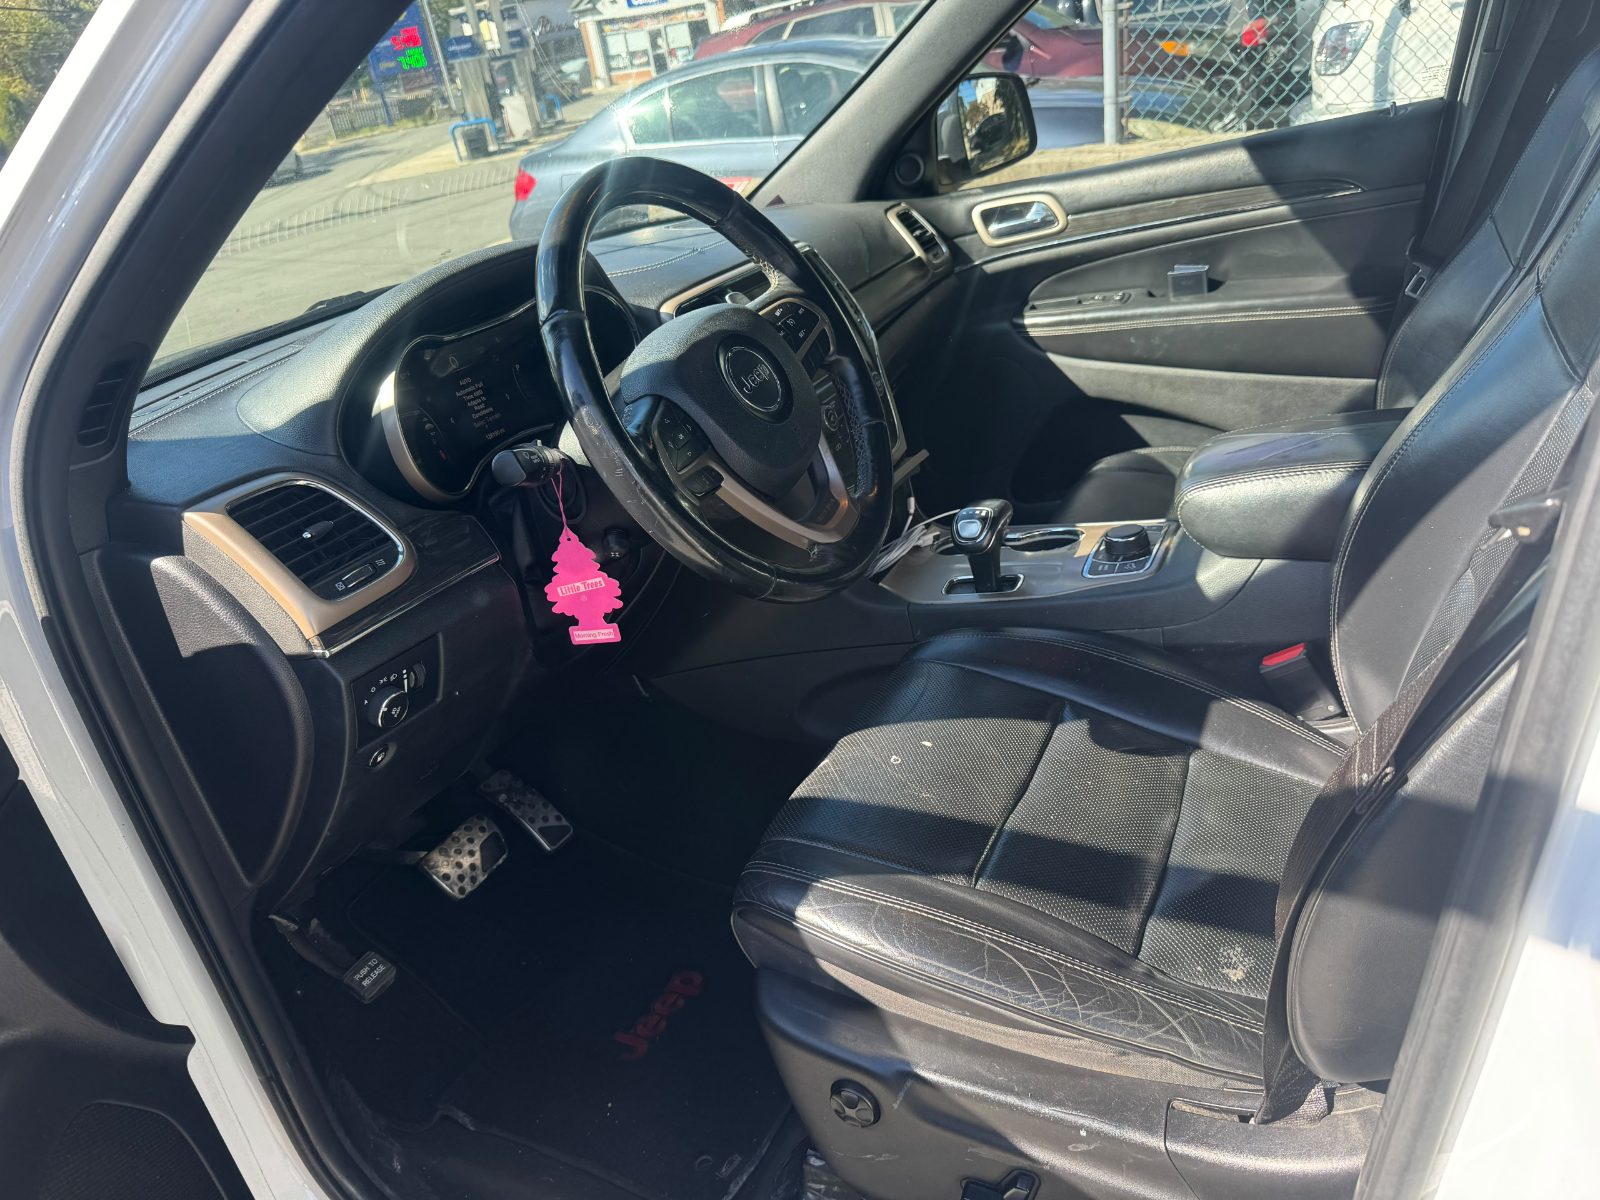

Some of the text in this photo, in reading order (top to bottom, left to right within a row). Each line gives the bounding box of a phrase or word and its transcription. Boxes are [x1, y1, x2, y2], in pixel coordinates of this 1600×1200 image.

[741, 363, 770, 394] Jeep
[560, 580, 602, 595] Little Trees
[574, 630, 614, 639] Morning Fresh
[353, 958, 378, 980] PUSH TO
[362, 964, 386, 987] RELEASE
[614, 969, 704, 1061] Jeep
